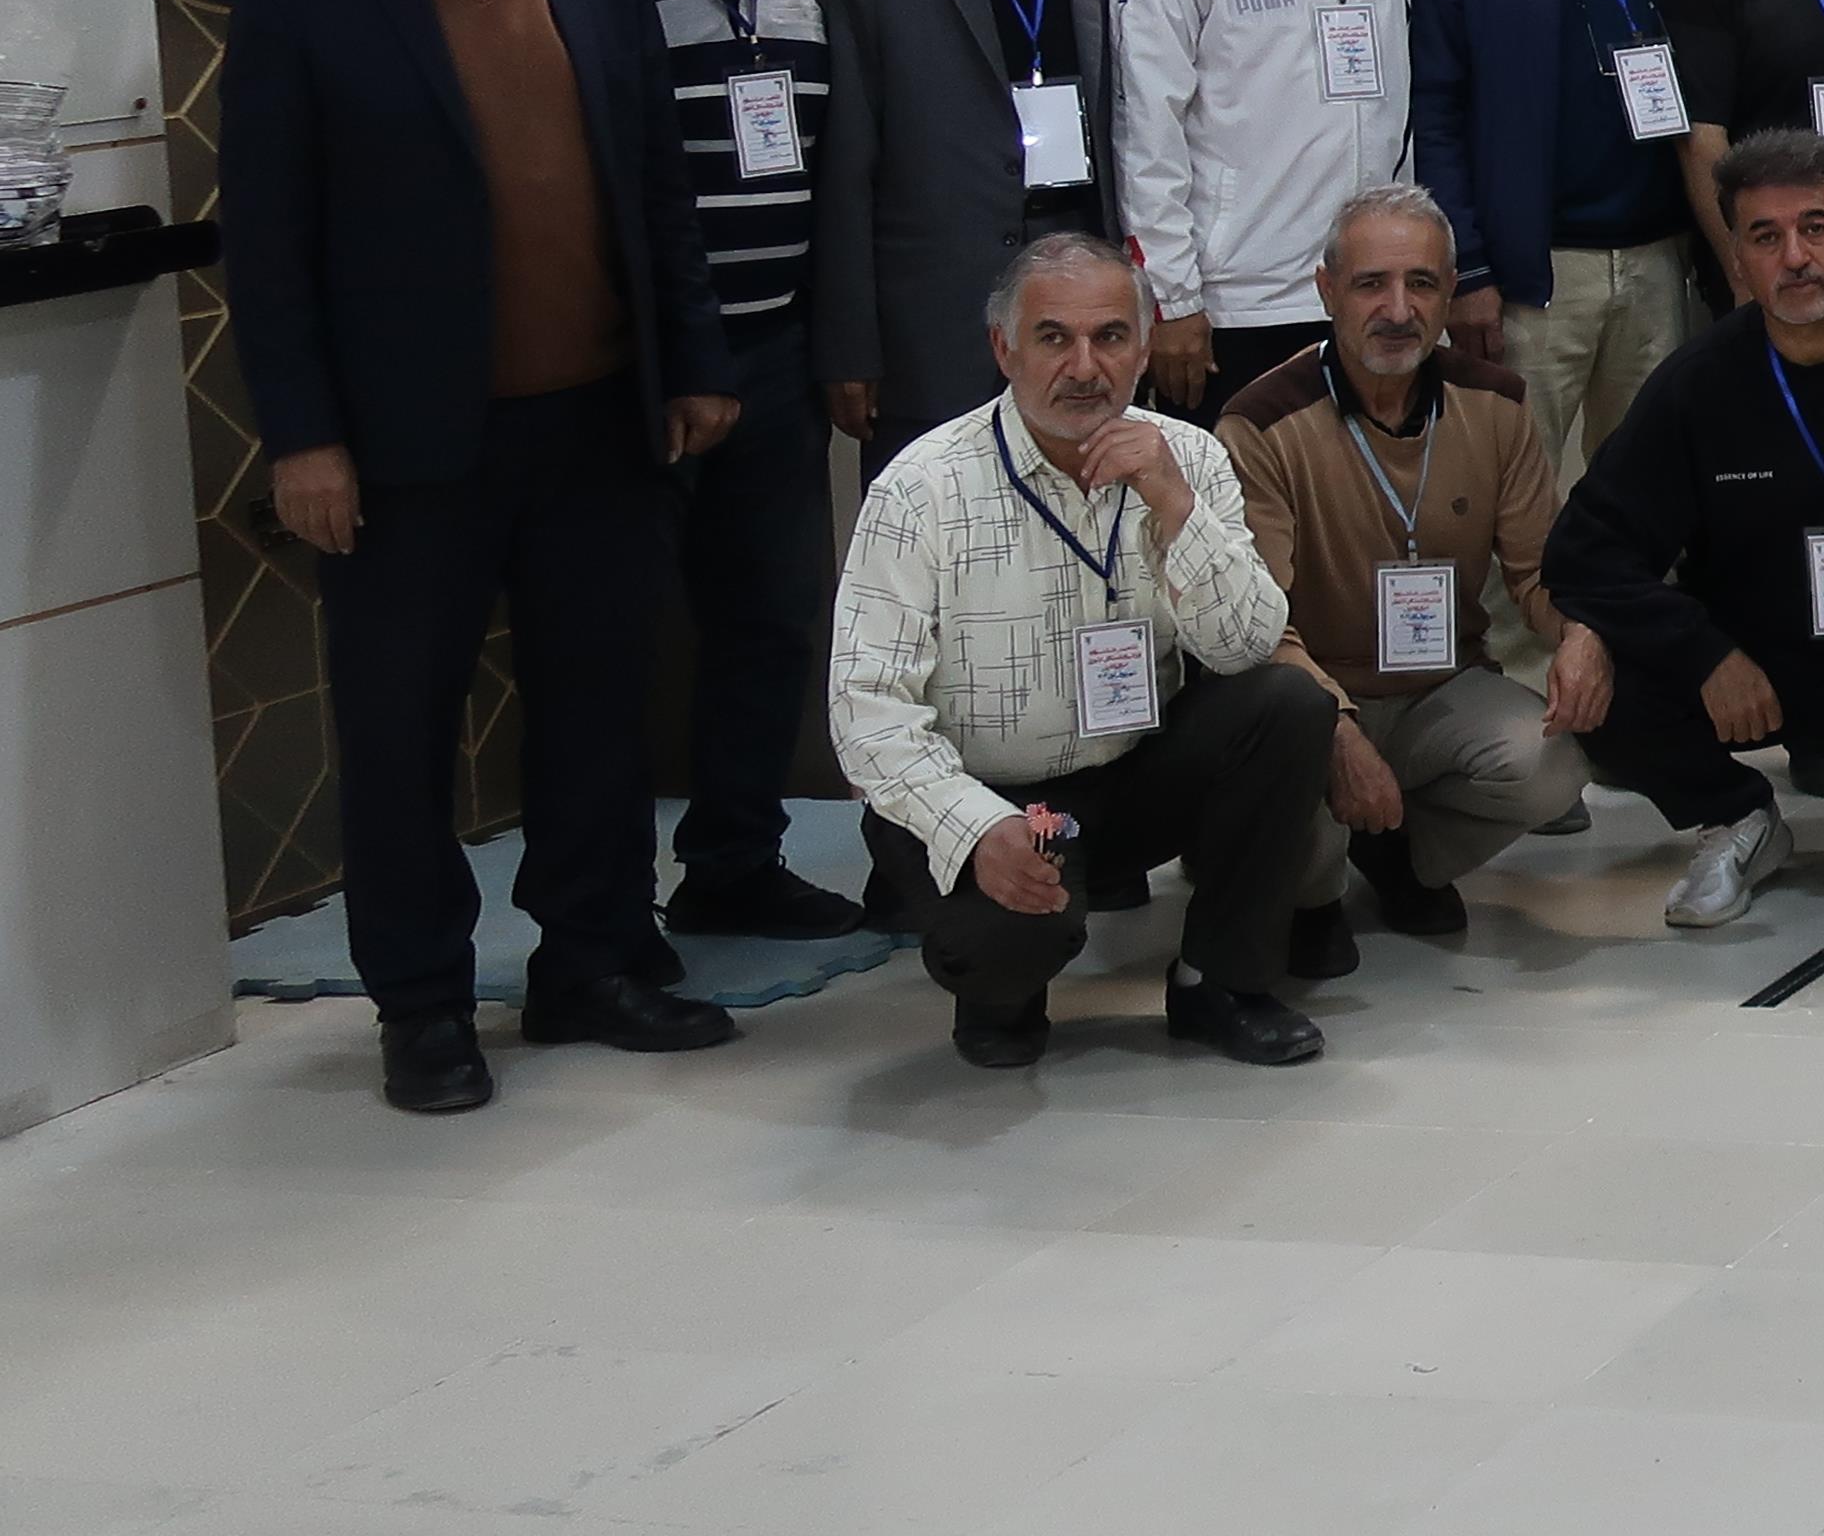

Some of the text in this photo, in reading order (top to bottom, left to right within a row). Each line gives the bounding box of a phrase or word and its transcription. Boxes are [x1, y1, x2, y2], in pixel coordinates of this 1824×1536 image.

[1715, 470, 1774, 483] ESSENCE OF LIFE
